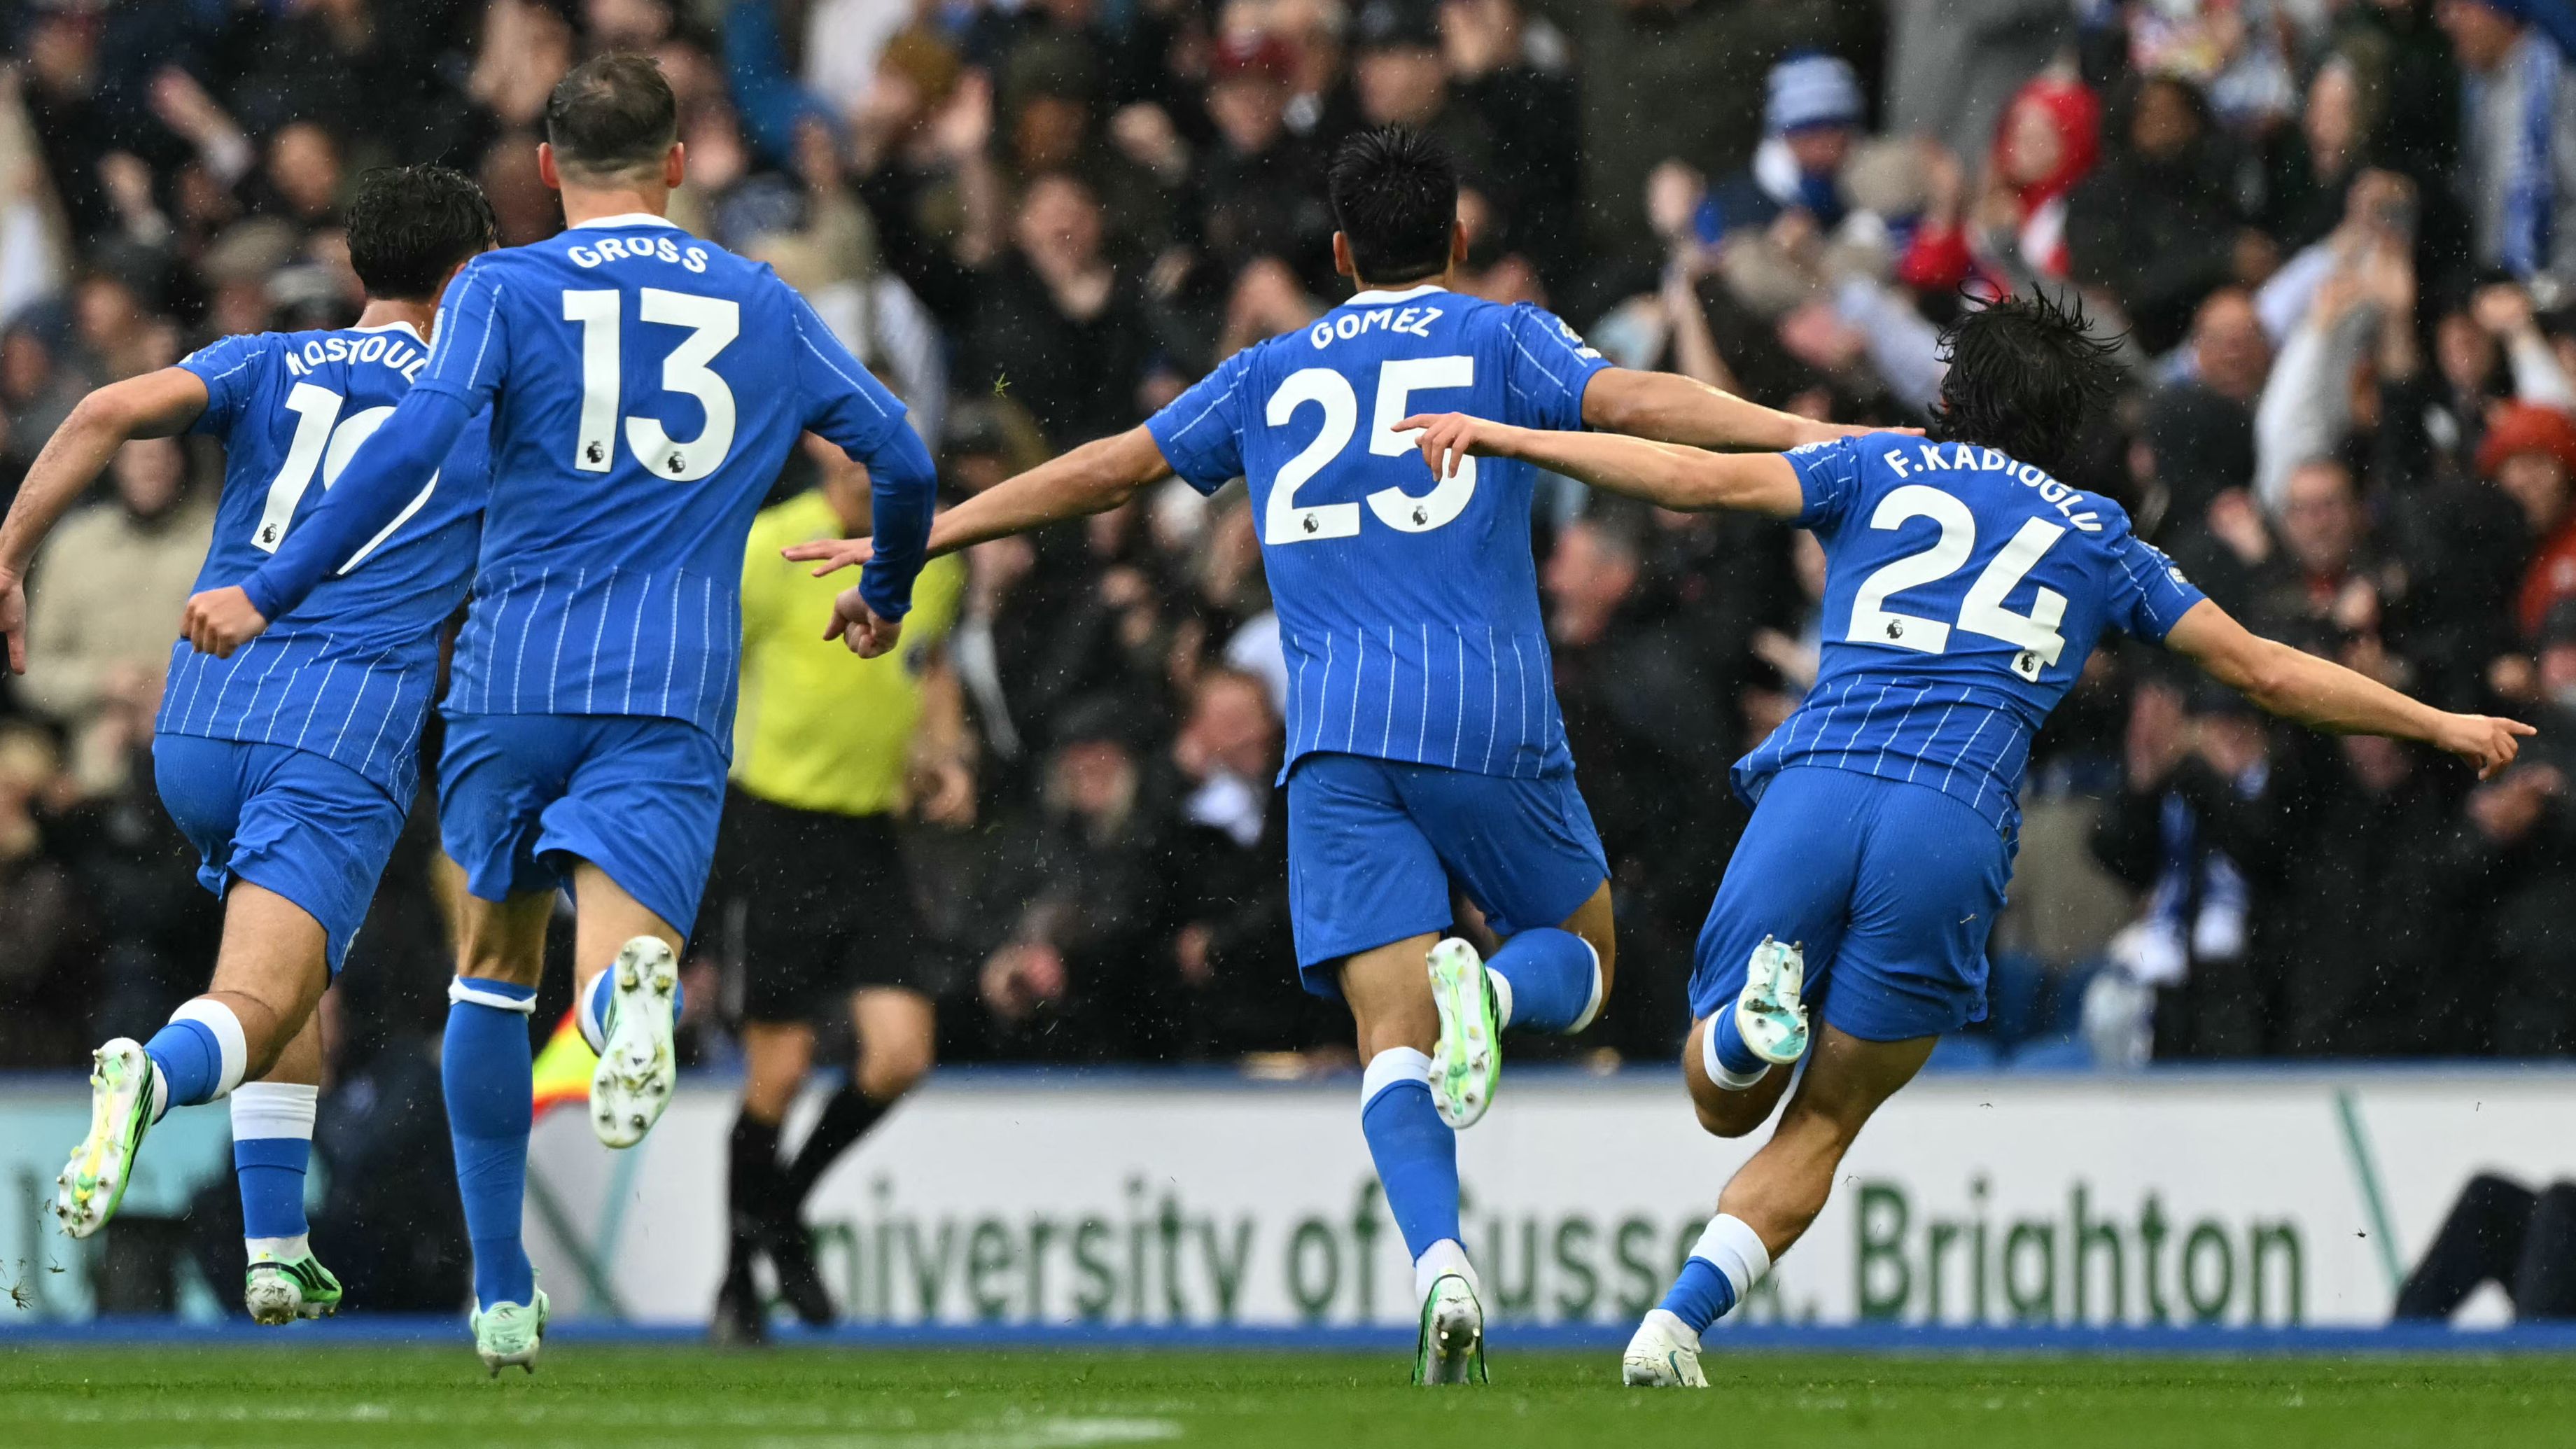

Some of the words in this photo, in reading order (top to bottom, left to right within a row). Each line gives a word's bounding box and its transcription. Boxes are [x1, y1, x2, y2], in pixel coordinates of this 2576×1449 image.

[568, 237, 708, 274] GROSS
[1310, 307, 1443, 350] GOMEZ
[562, 287, 740, 482] 13
[1265, 355, 1477, 545] 25
[1845, 484, 2068, 682] 24
[766, 1175, 1256, 1323] niversity
[1287, 1172, 1385, 1323] of
[1855, 1176, 2306, 1324] Brighton
